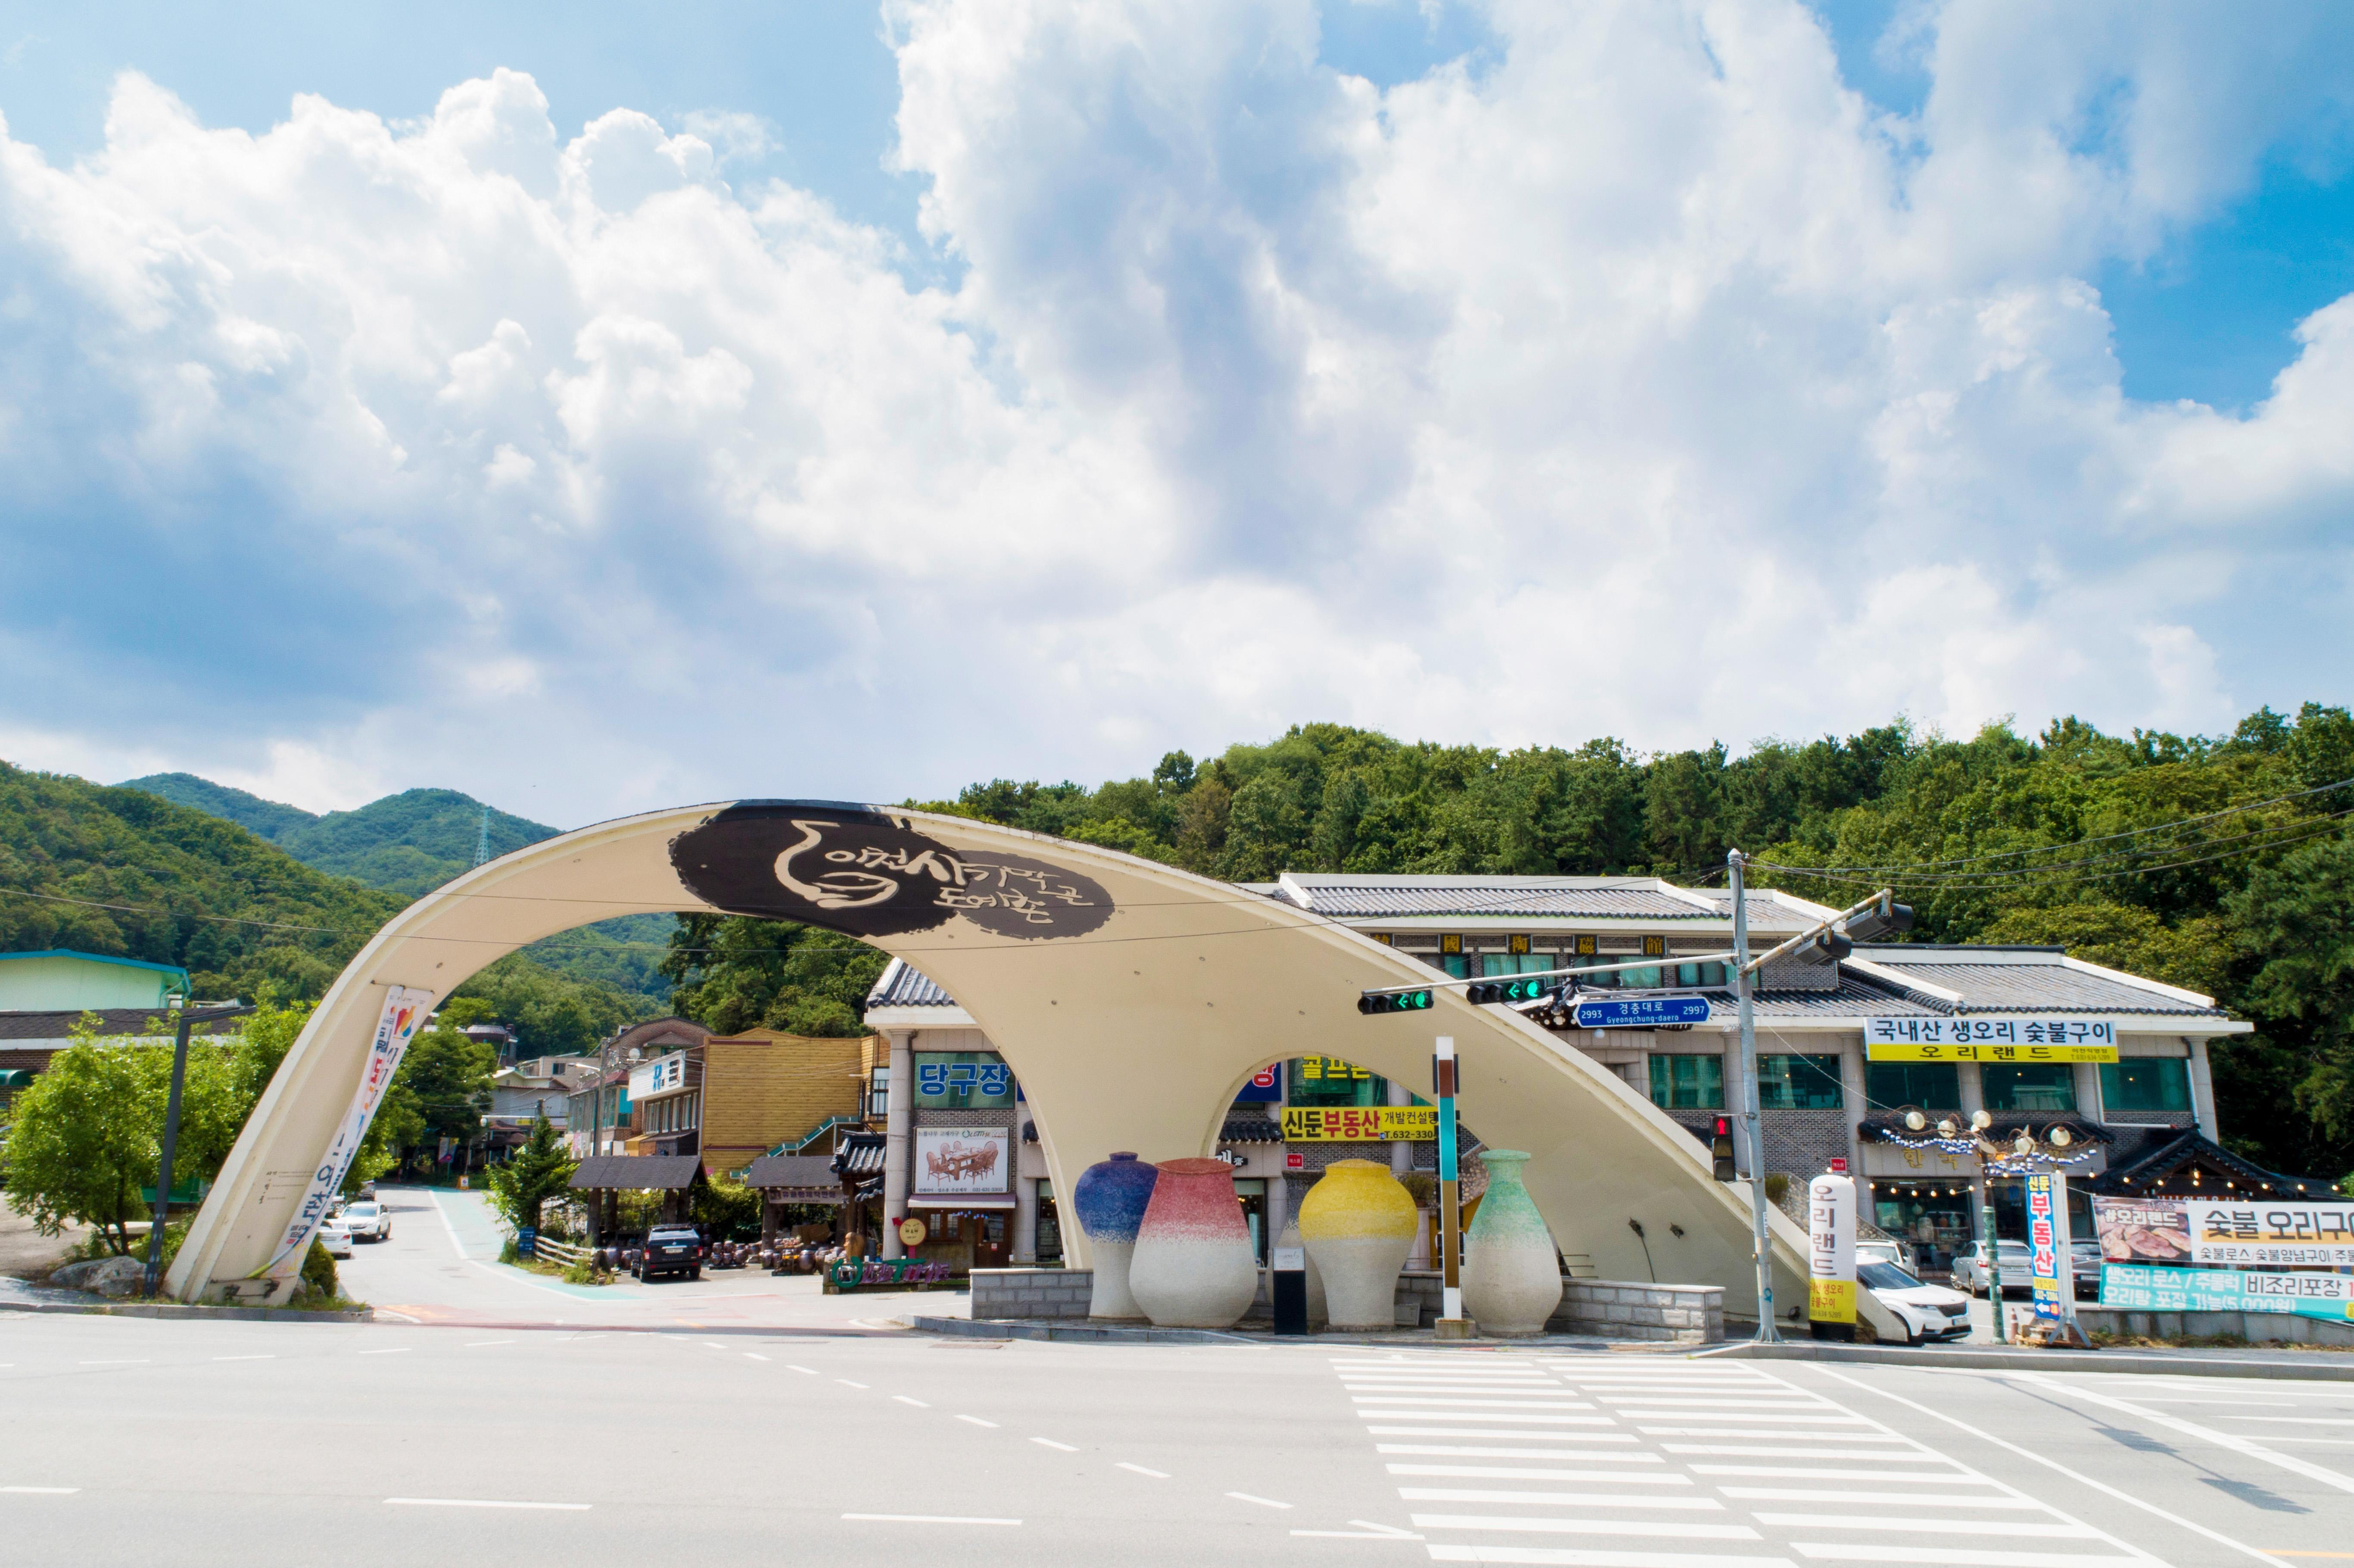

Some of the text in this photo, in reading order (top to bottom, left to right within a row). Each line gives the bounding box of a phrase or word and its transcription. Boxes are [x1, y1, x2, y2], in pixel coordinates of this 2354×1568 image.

[1582, 1002, 1705, 1019] 2993 경충대로 2997
[1607, 1015, 1679, 1024] Gyeongchung-daero
[1874, 1020, 2112, 1044] 국내산 생오리 숯불구이
[1919, 1046, 2052, 1061] 오리랜드
[919, 1063, 1010, 1096] 당구장
[1812, 1185, 1837, 1276] 오리랜드
[2105, 1208, 2179, 1227] #오리랜드
[2205, 1210, 2259, 1240] 숯불
[2031, 1195, 2052, 1274] 부동산
[2106, 1266, 2150, 1286] 생오리
[2152, 1270, 2182, 1289] 로스
[2247, 1276, 2342, 1297] 비조리포장
